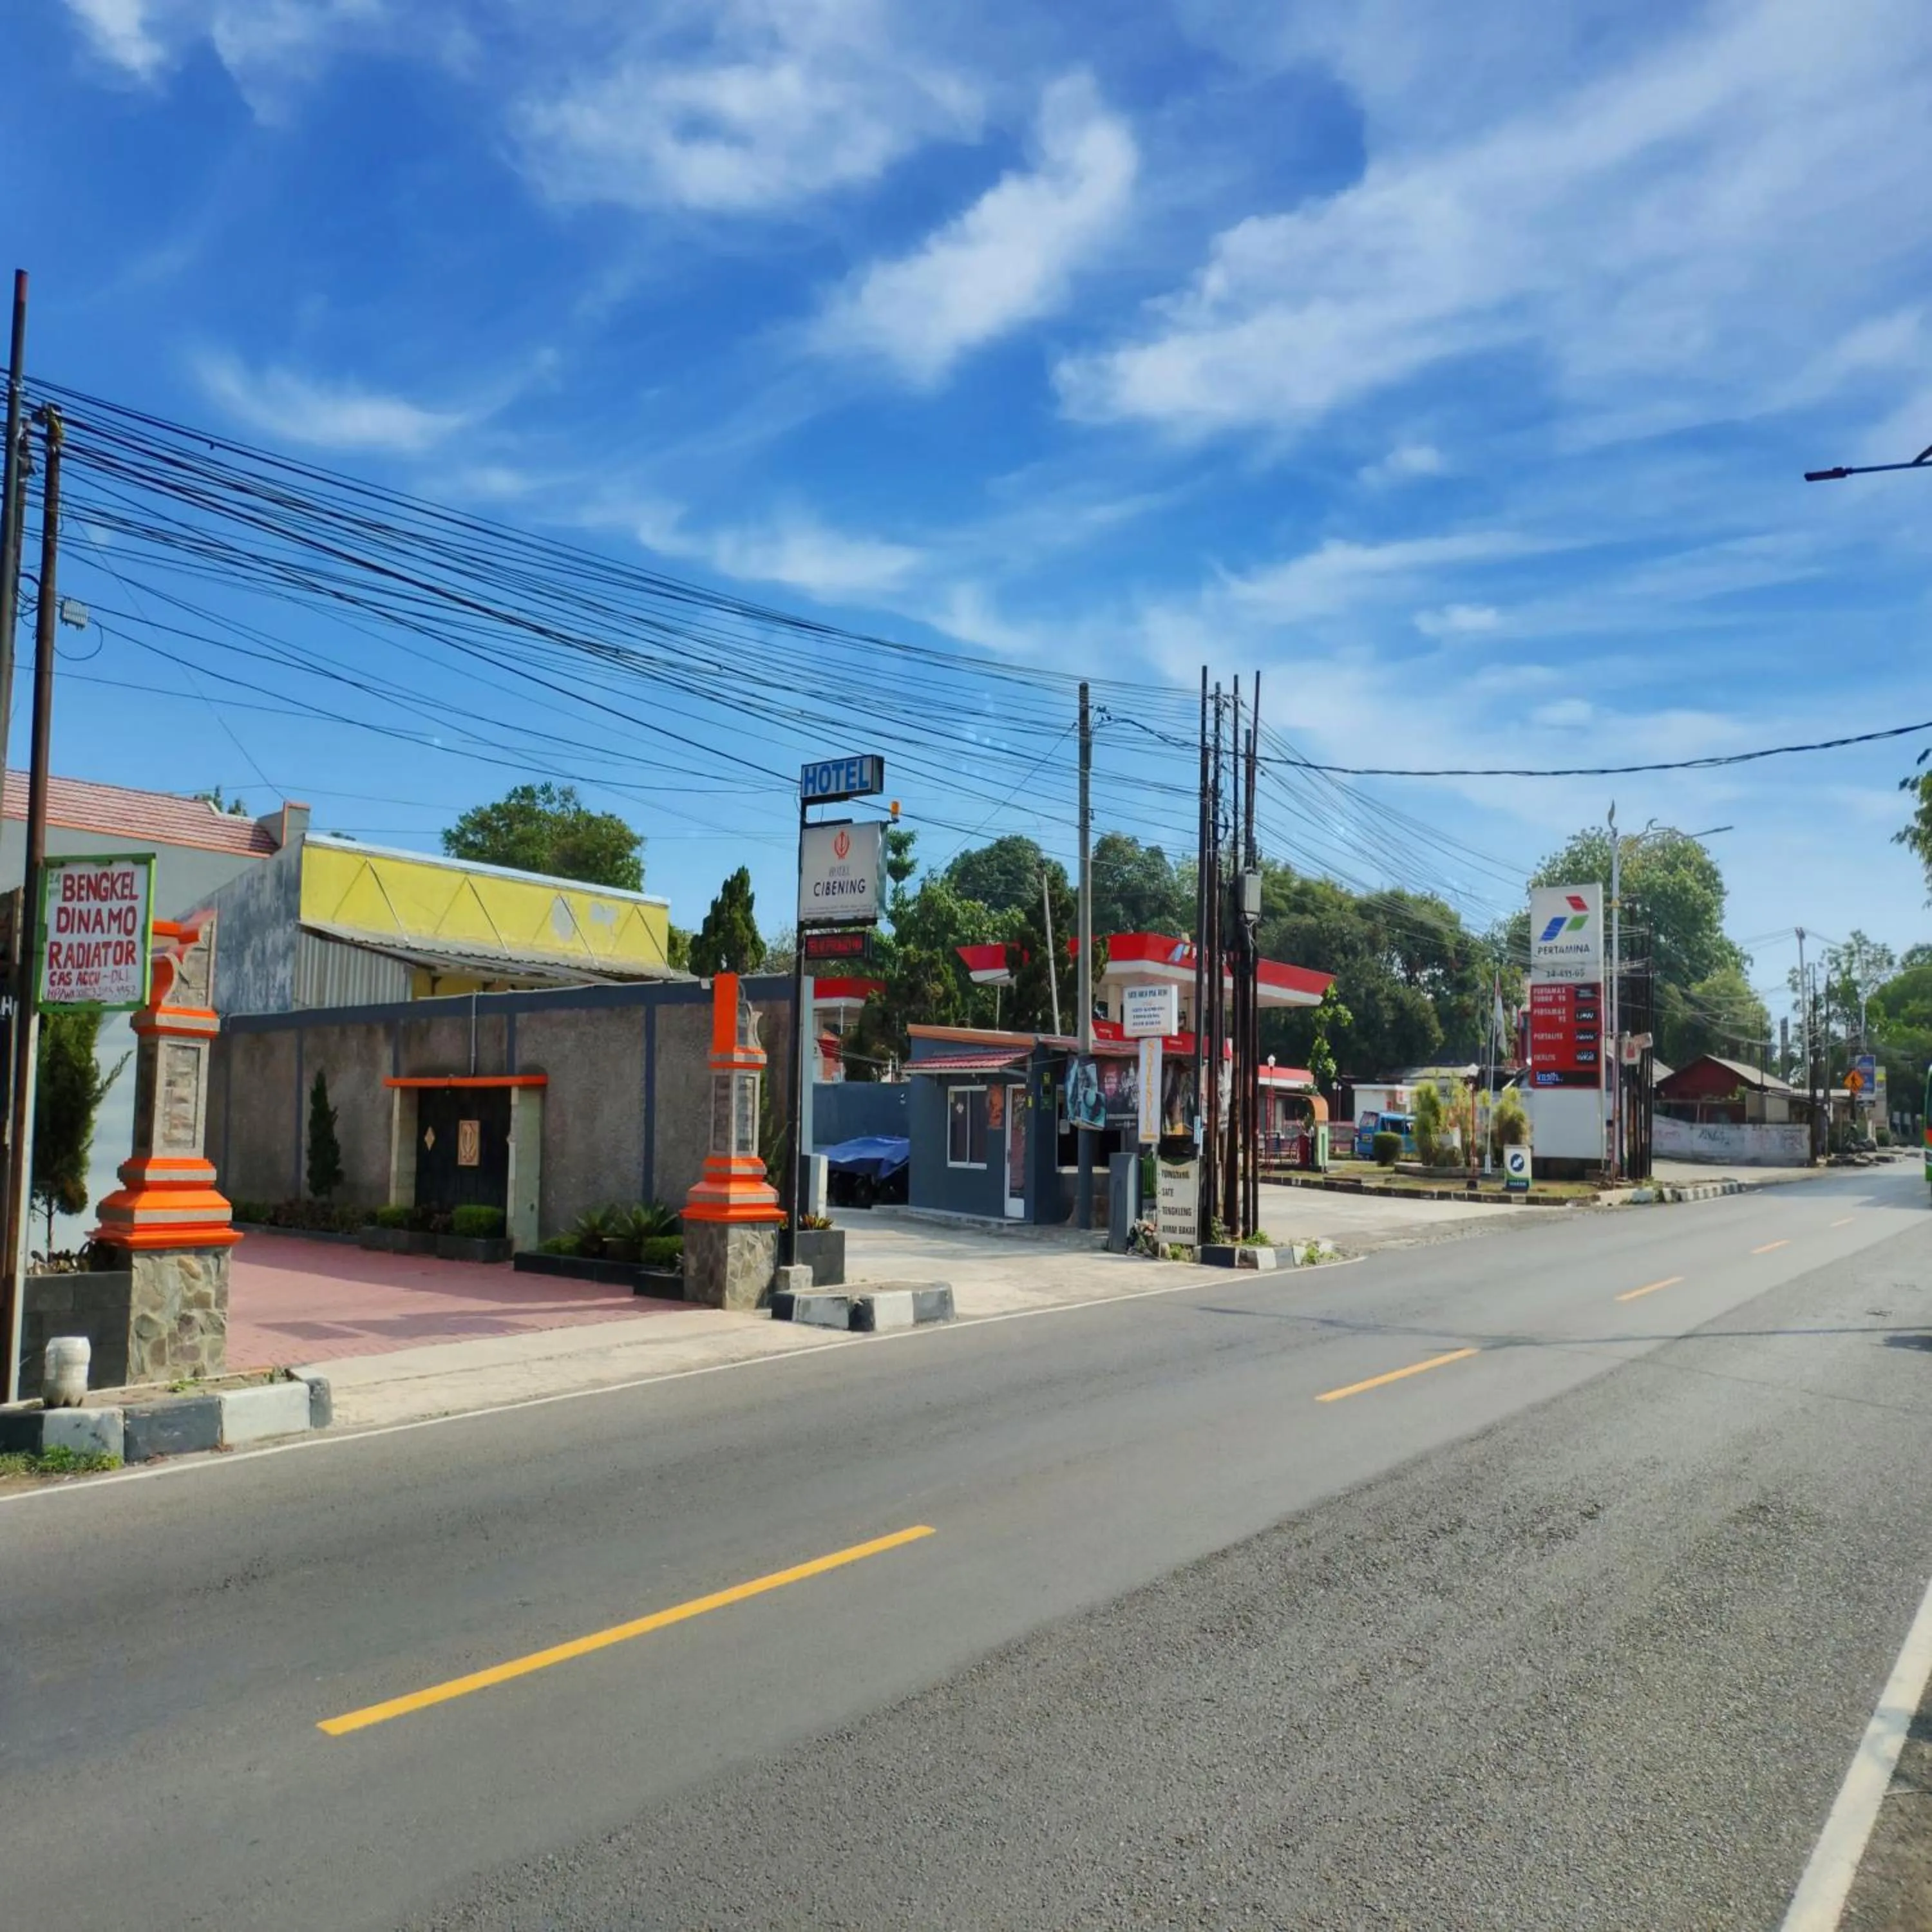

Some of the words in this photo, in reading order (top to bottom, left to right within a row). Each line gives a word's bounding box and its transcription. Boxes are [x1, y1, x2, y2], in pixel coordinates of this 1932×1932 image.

[804, 759, 869, 795] HOTEL
[62, 871, 139, 902] BENGKEL
[813, 878, 866, 897] CIBENING
[56, 905, 137, 936] DINAMO
[48, 940, 137, 969] RADIATOR
[1537, 943, 1590, 954] PERTAMINA
[49, 971, 72, 987] CAS
